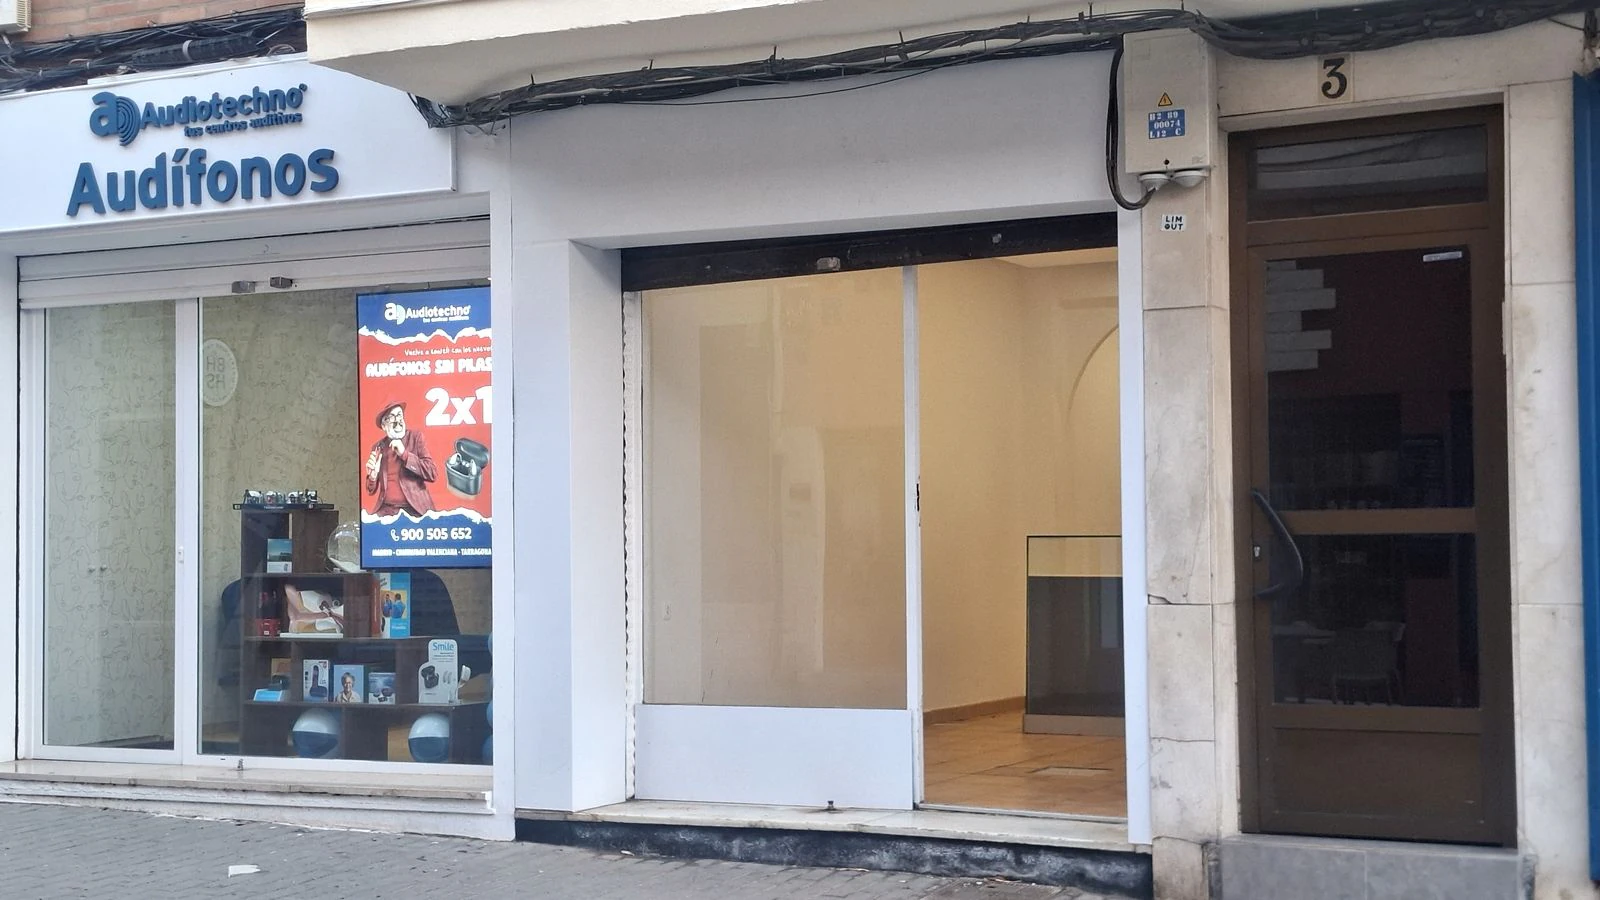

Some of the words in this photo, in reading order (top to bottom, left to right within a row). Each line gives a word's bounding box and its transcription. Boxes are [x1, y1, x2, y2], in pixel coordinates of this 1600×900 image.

[1321, 57, 1348, 99] 3
[140, 84, 307, 130] Audiotechno
[184, 124, 203, 138] tus
[205, 119, 247, 136] centros
[249, 111, 303, 128] auditivos
[66, 147, 340, 217] Audífonos
[1164, 223, 1184, 231] OUT
[1165, 215, 1183, 223] LIM
[405, 304, 471, 320] Audiotechno
[365, 357, 431, 378] AUDÍFONOS
[434, 358, 455, 374] SIN
[457, 356, 492, 373] PILAS
[424, 385, 492, 426] 2x1
[400, 528, 424, 541] 900
[426, 527, 448, 541] 505
[450, 527, 473, 540] 652
[432, 641, 455, 651] Smile
